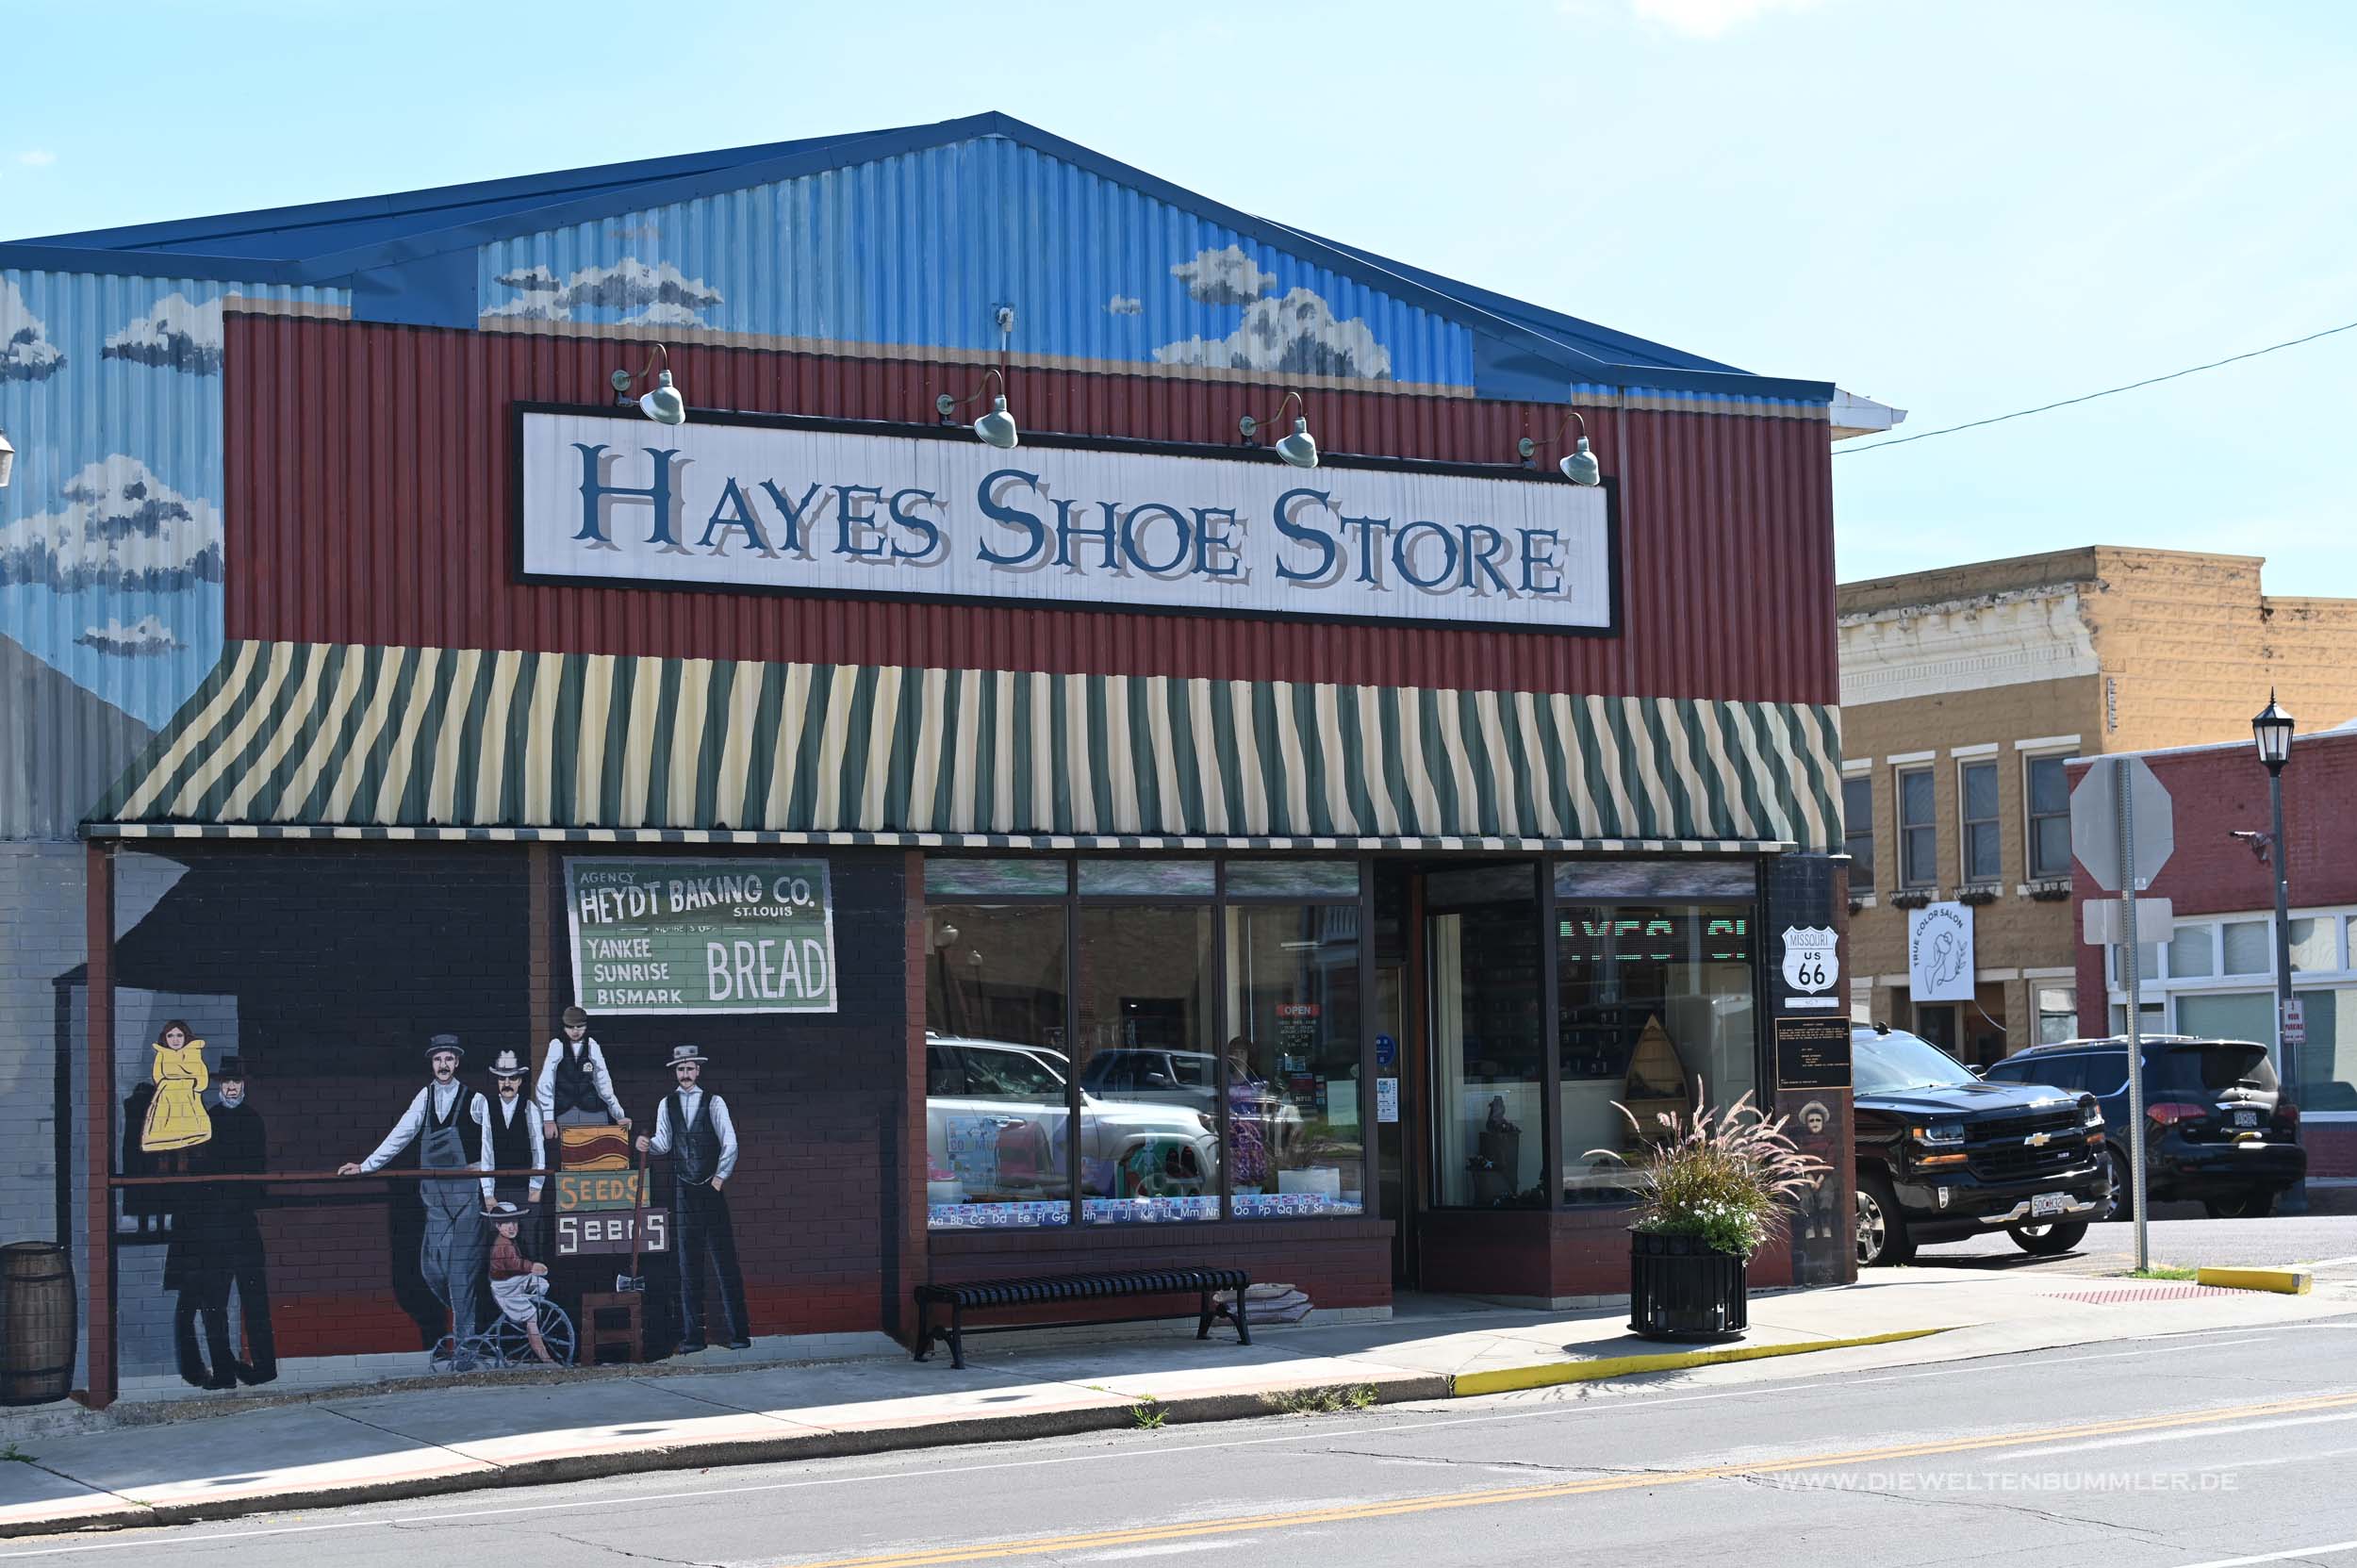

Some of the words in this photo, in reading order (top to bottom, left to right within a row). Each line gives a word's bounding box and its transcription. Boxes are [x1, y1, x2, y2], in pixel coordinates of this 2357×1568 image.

[571, 441, 945, 563] HAYES
[977, 468, 1246, 582] SHOE
[1273, 487, 1566, 599] STORE
[580, 871, 636, 884] AGENCY
[580, 881, 660, 924] HEYDT
[668, 874, 763, 914] BAKING
[773, 876, 816, 907] CO.
[1917, 909, 1938, 936] COLOR
[1939, 908, 1963, 929] SALON
[1789, 933, 1828, 947] MISSOURI
[1804, 951, 1821, 960] US
[586, 938, 652, 959] YANKEE
[707, 938, 828, 1001] BREAD
[594, 963, 669, 982] SUNRISE
[1798, 962, 1825, 985] 66
[597, 988, 684, 1005] BISMARK
[1284, 1006, 1312, 1015] OPEN
[559, 1174, 648, 1209] SEEDS
[1082, 1210, 1096, 1221] Hh
[1140, 1208, 1155, 1219] Kk
[1180, 1207, 1199, 1217] Mm
[1206, 1207, 1220, 1216] Nn
[1234, 1206, 1249, 1215] Oo
[1258, 1205, 1271, 1216] Pp
[1277, 1205, 1293, 1215] Qq
[1298, 1204, 1309, 1213] Rr
[1313, 1204, 1324, 1213] Ss
[929, 1216, 944, 1226] Aa
[950, 1215, 964, 1225] Bb
[970, 1214, 986, 1225] Cc
[992, 1213, 1007, 1224] Dd
[1017, 1213, 1030, 1223] Ee
[1051, 1212, 1068, 1224] Gg
